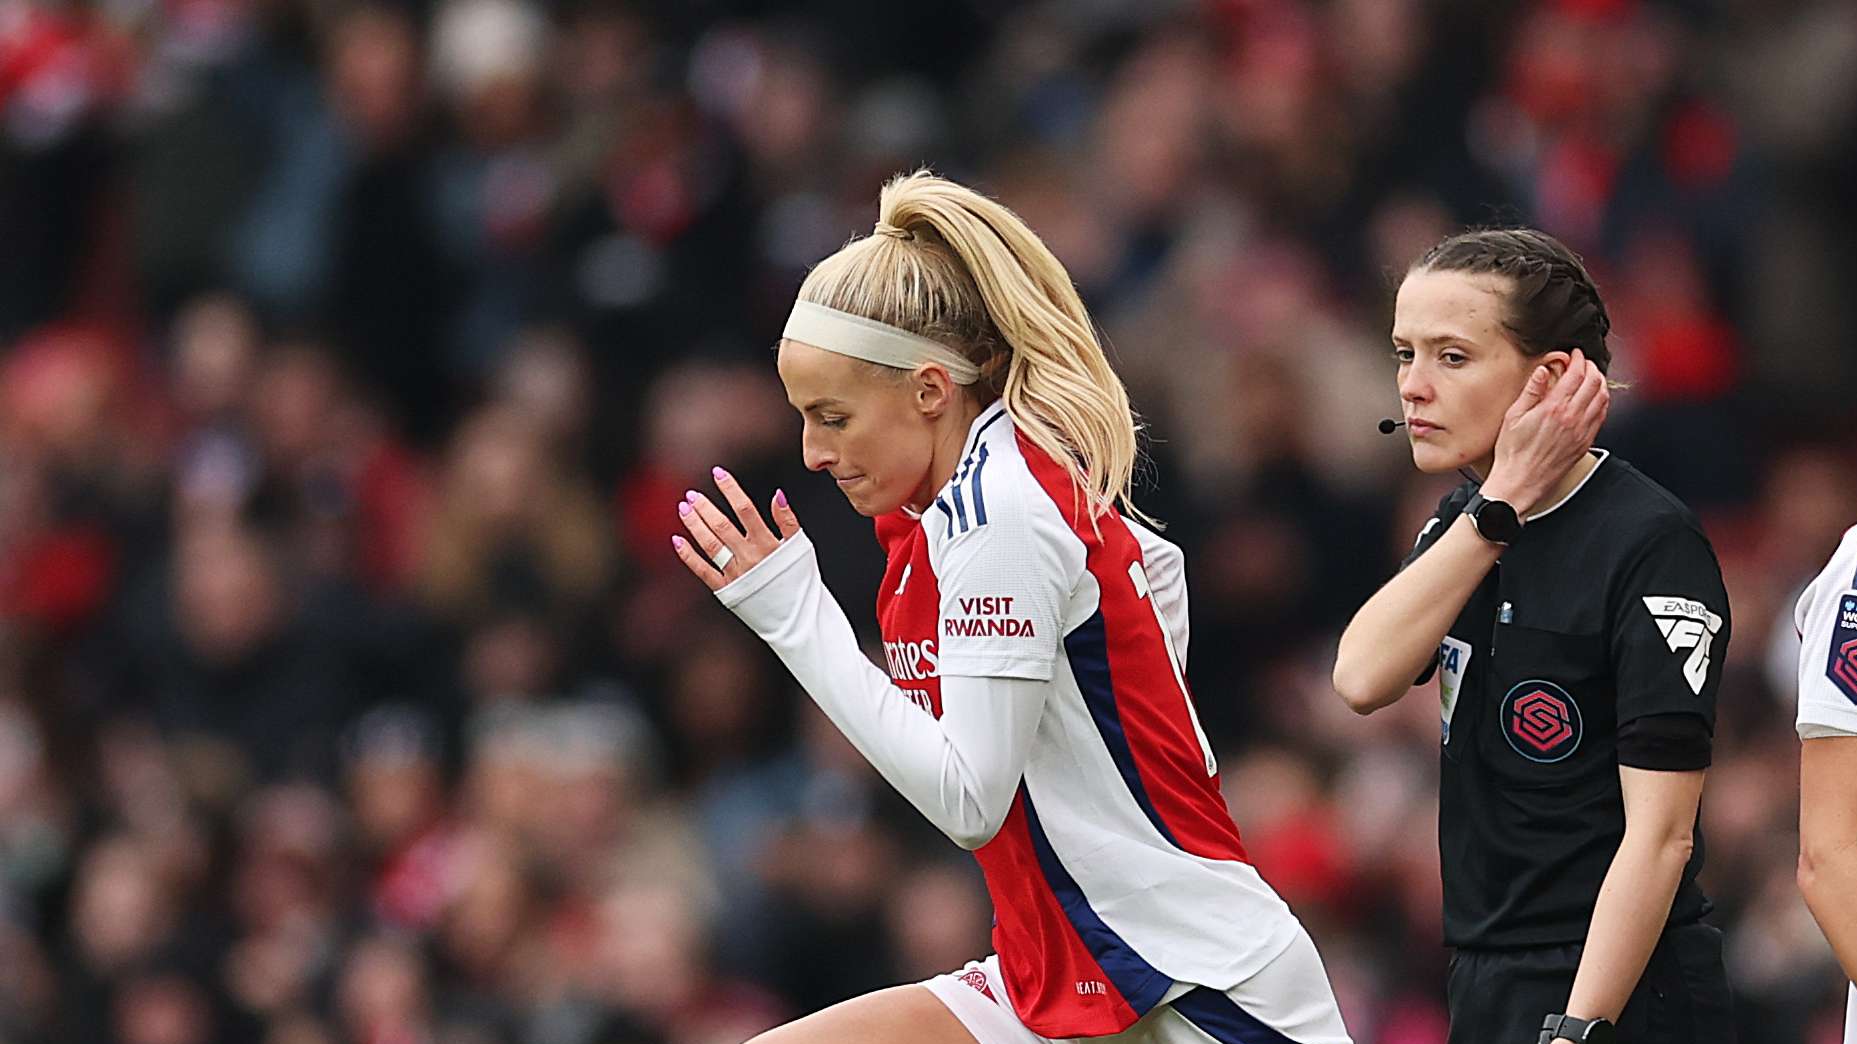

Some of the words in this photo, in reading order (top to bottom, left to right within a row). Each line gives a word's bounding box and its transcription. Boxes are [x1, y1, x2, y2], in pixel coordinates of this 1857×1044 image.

[959, 597, 1014, 615] VISIT
[945, 619, 1035, 637] RWANDA
[884, 637, 939, 681] rates
